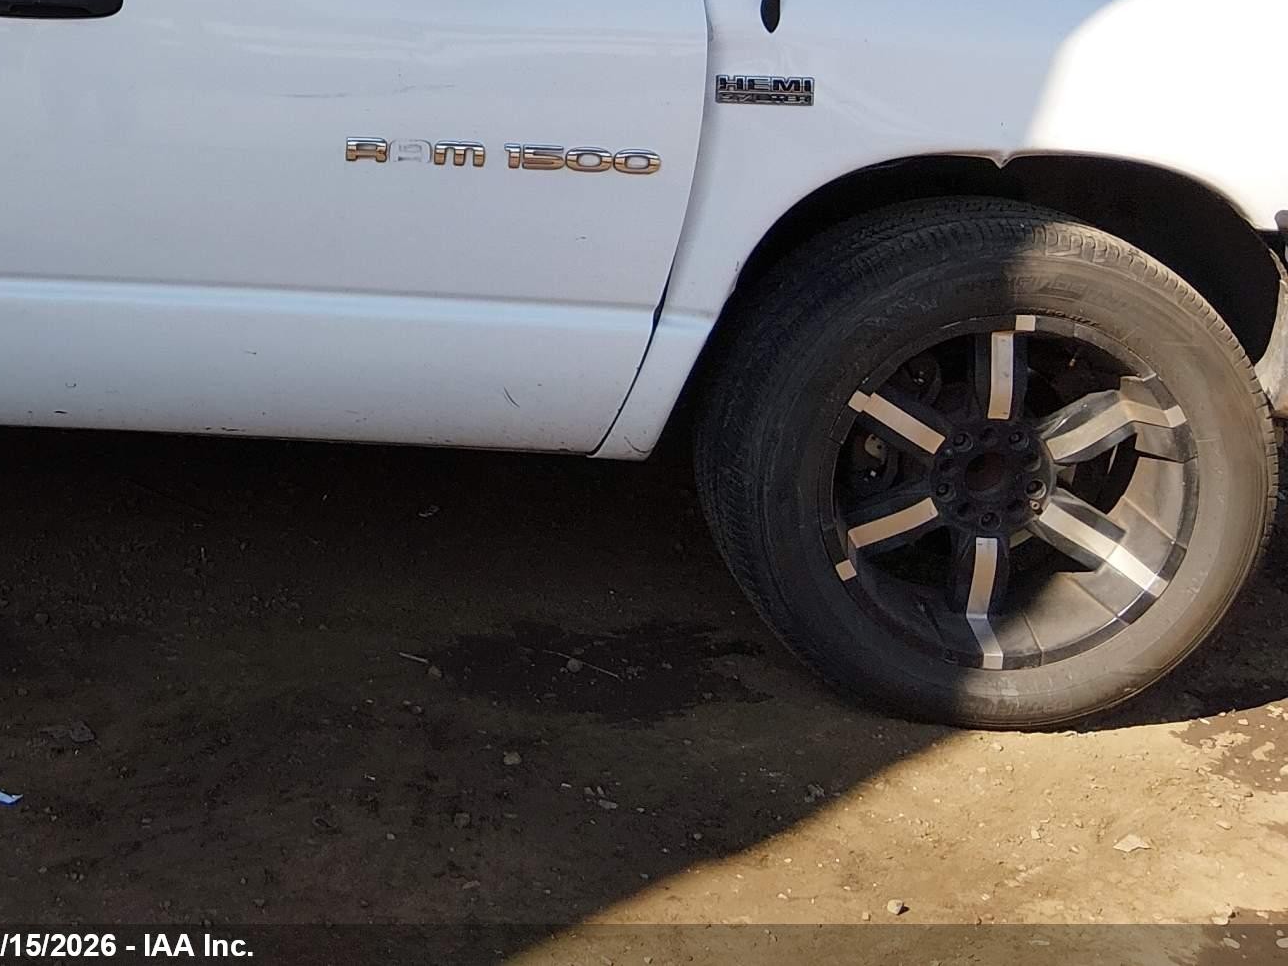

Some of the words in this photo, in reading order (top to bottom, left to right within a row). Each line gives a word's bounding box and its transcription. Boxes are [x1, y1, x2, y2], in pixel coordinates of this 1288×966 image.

[716, 74, 815, 93] HEMI
[345, 137, 486, 167] RAM
[504, 142, 662, 175] 1500
